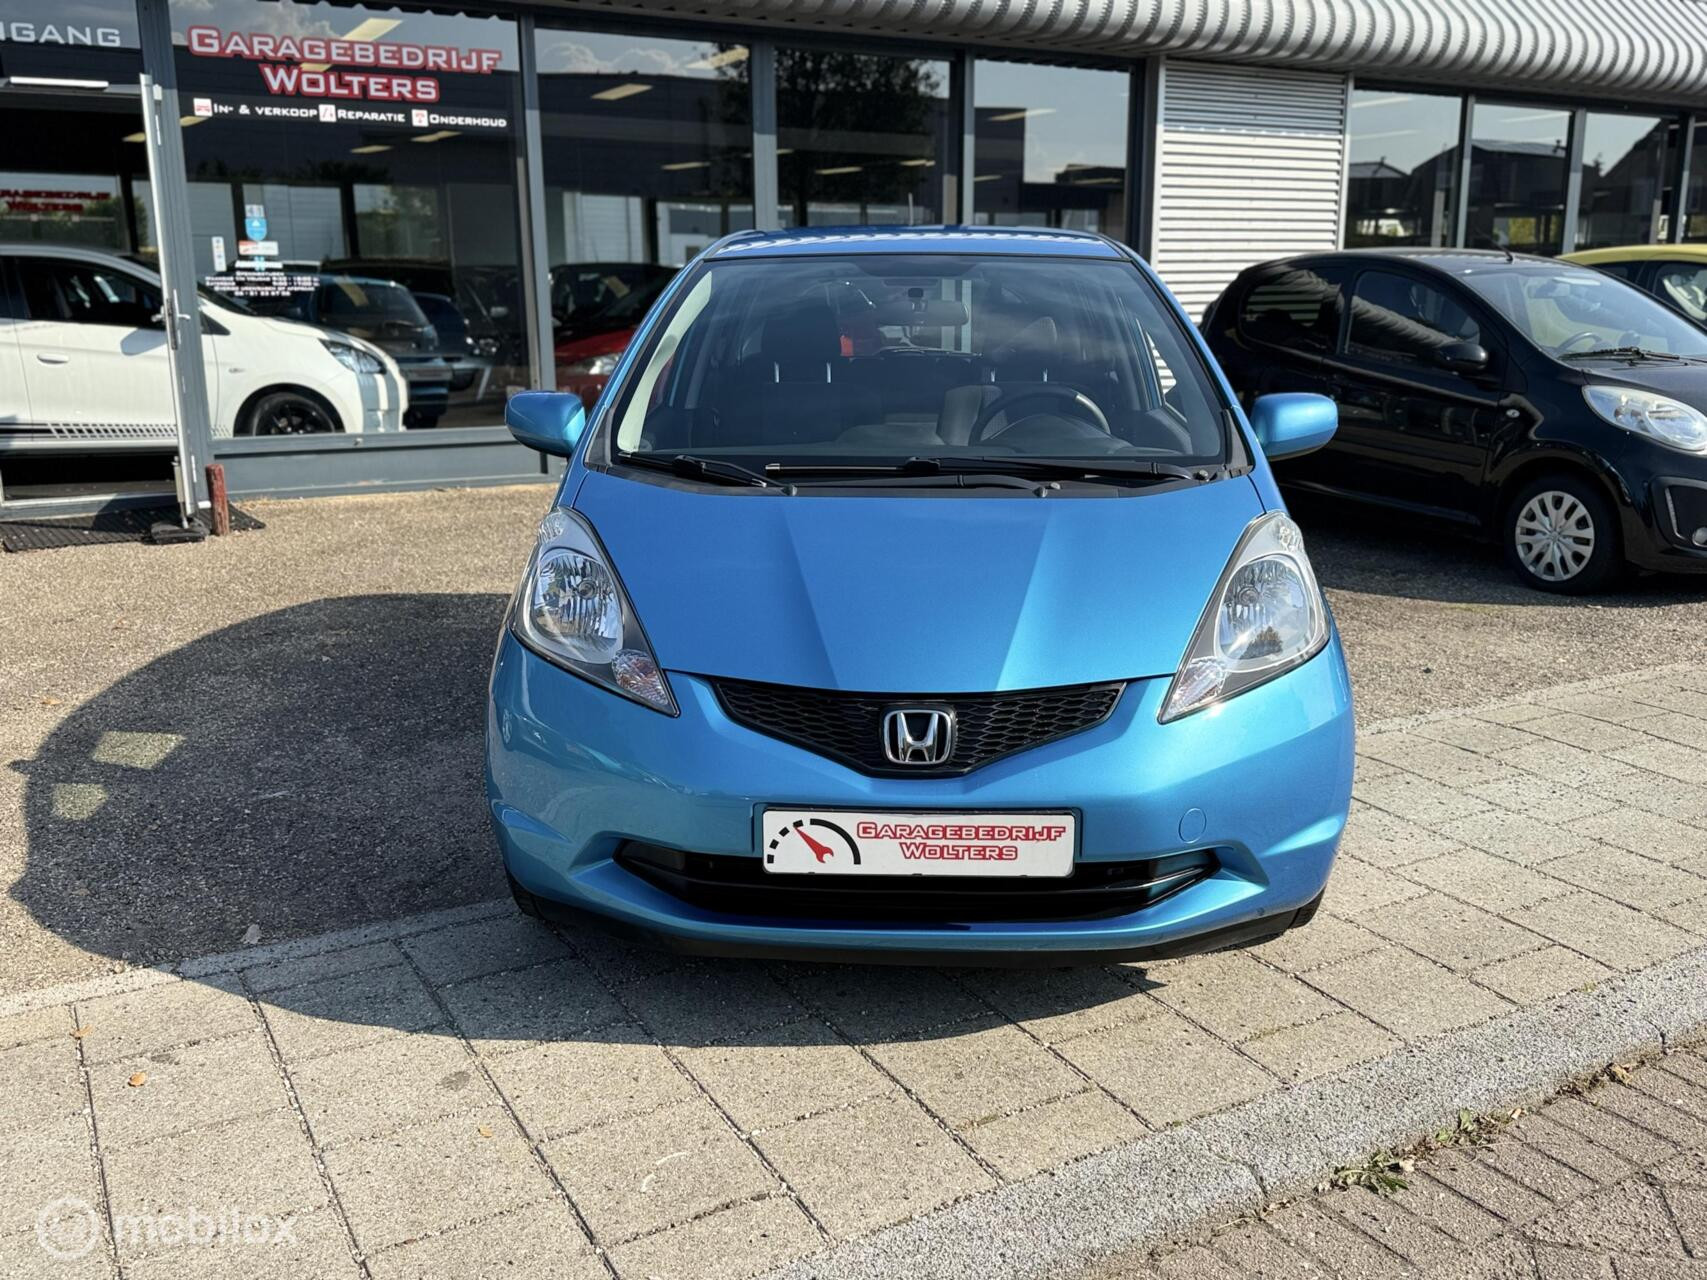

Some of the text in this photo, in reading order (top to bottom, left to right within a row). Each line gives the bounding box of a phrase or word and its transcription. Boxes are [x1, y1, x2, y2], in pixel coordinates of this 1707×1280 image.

[0, 21, 121, 47] GANG
[188, 25, 501, 74] GARAGEBEDRIJF
[259, 63, 440, 102] WOLTERS
[239, 104, 251, 115] &
[255, 106, 318, 118] VERKOOP
[337, 108, 406, 123] REPARATIE
[429, 114, 507, 128] ONDERHOUD
[857, 821, 1066, 842] GARAGEBEDRIJF
[899, 842, 1018, 861] WOLTERS
